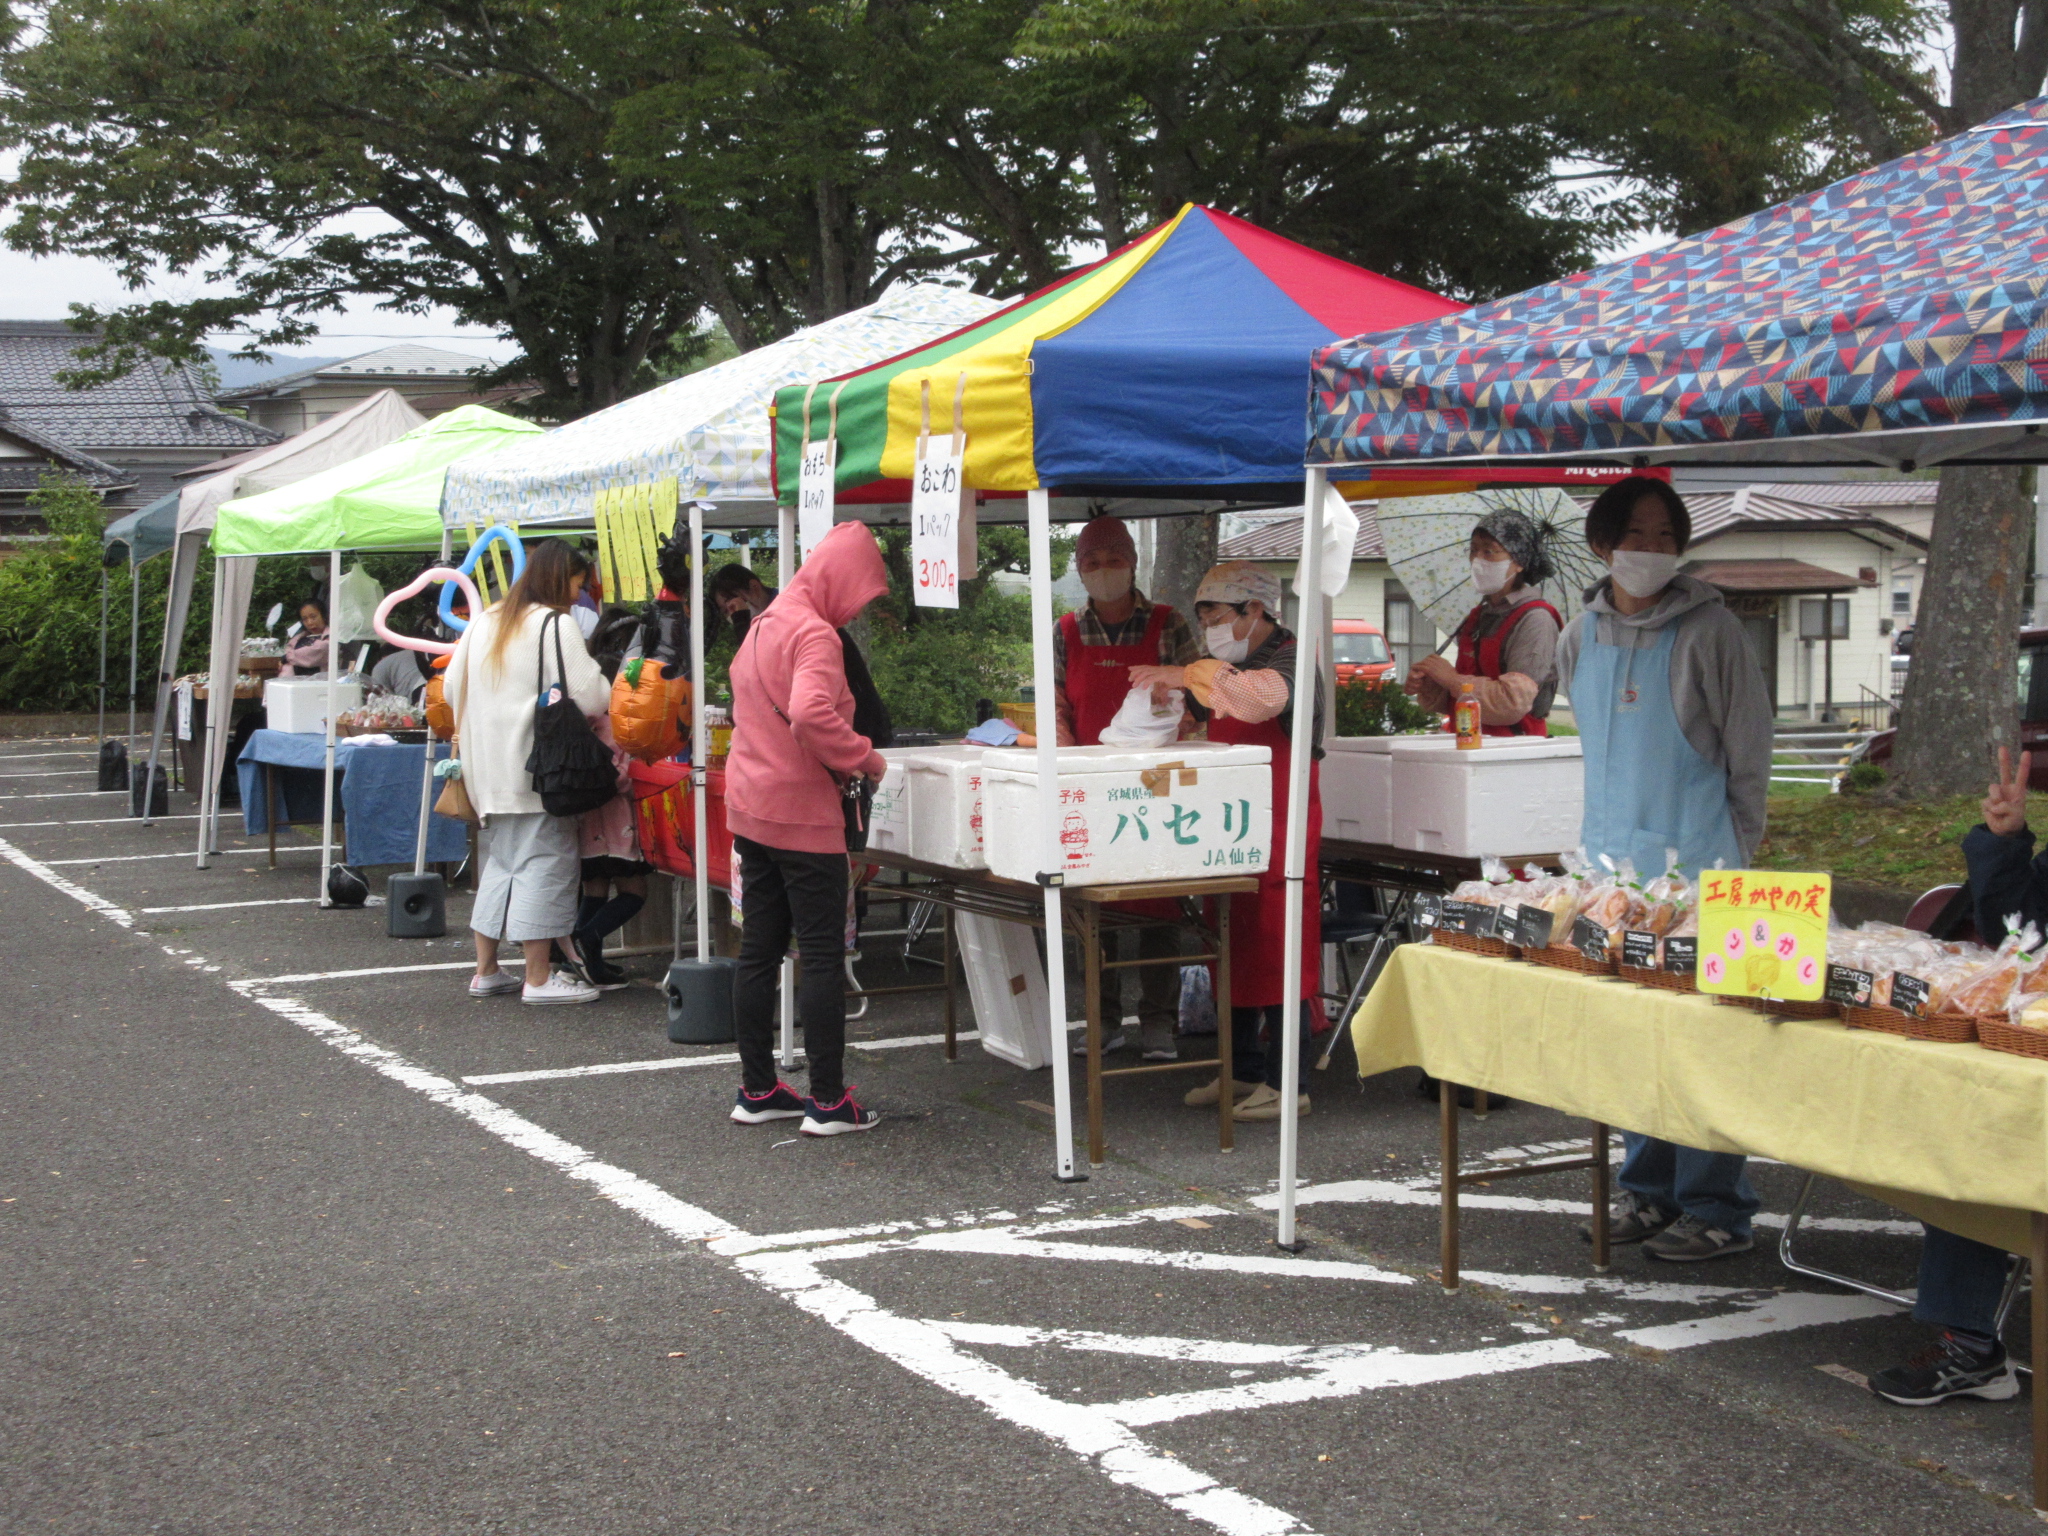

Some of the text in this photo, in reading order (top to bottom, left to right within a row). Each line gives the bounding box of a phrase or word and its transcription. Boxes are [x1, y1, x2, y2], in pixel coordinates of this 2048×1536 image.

[804, 452, 826, 477] おもち
[920, 463, 957, 494] おこわ
[919, 558, 956, 596] 300円
[1059, 789, 1087, 804] 予冷
[1109, 799, 1250, 845] パセリ
[1202, 846, 1263, 867] JA仙台
[1705, 877, 1826, 918] 工房かやの実
